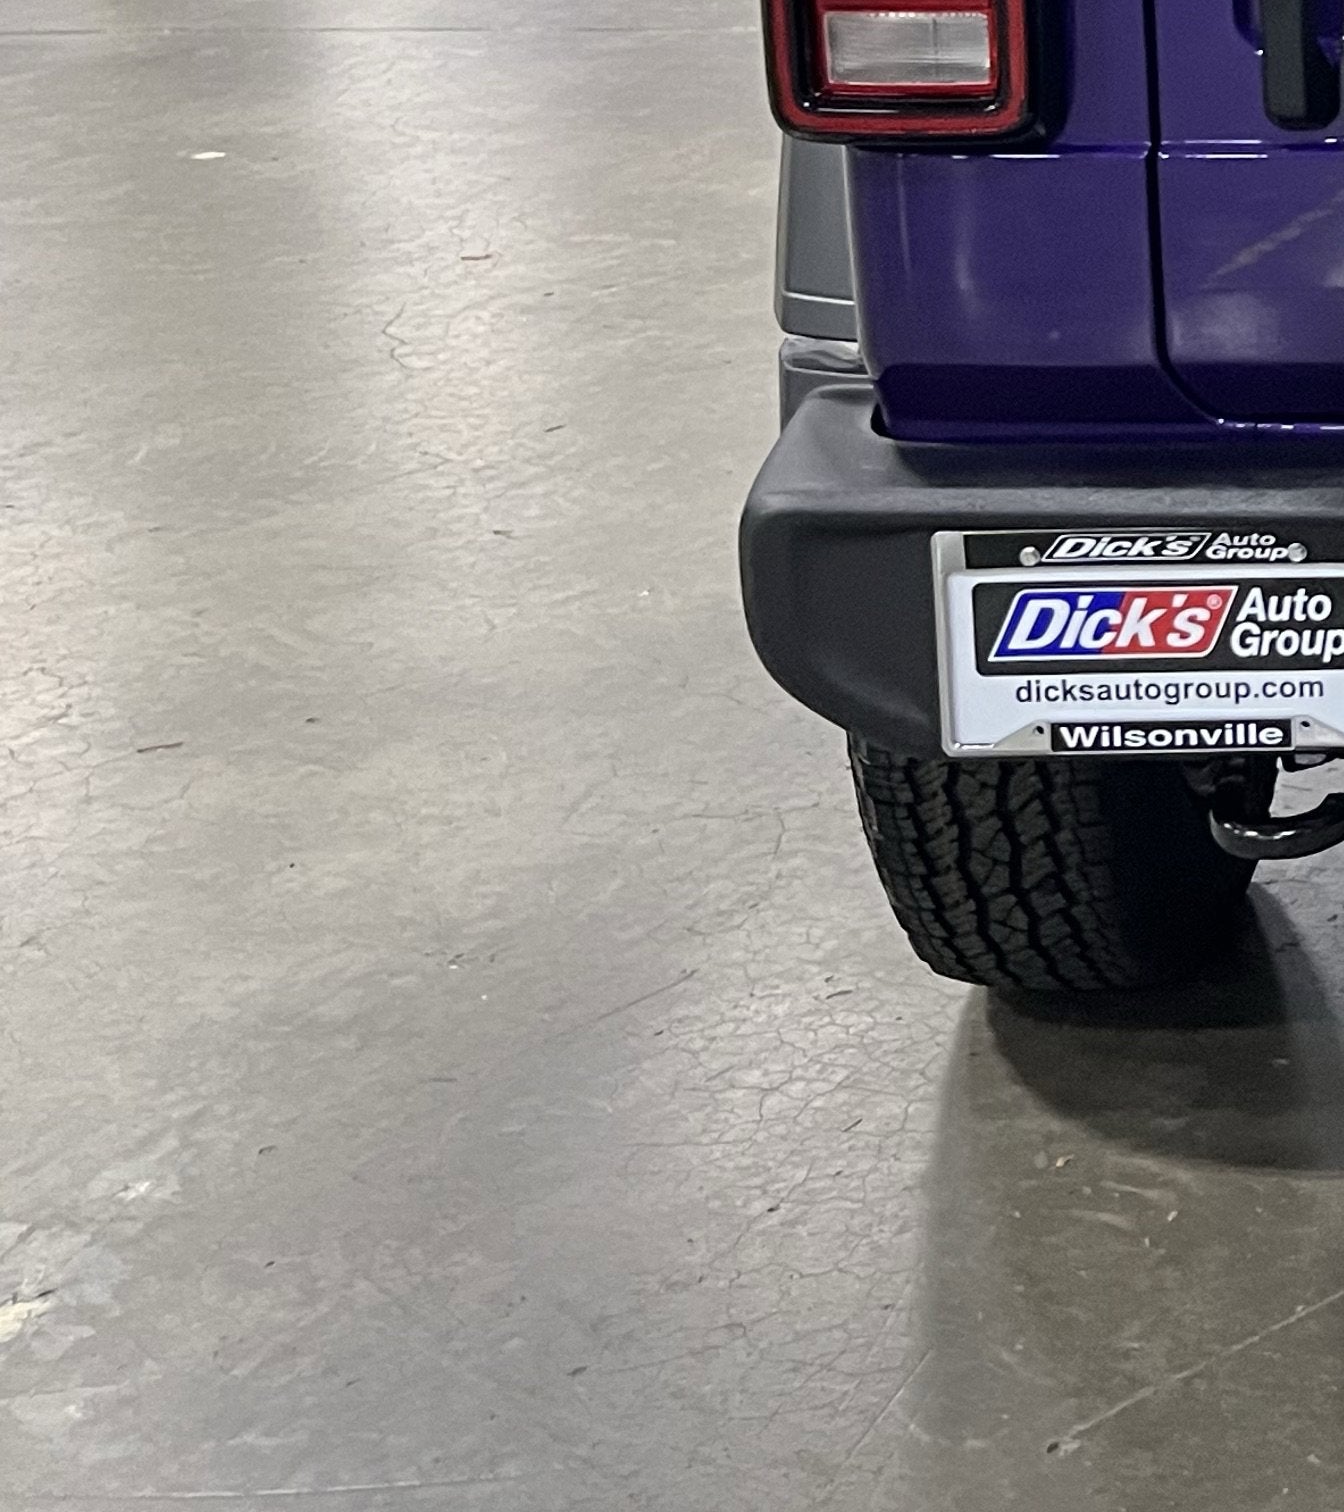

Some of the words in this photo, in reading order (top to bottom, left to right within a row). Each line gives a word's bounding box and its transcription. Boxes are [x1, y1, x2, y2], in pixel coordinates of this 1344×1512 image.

[1212, 533, 1276, 546] Auto
[1206, 544, 1289, 561] Group
[1236, 587, 1332, 622] Auto
[1007, 594, 1210, 649] Dick's
[1016, 679, 1324, 705] dicksautogroup.com
[1060, 723, 1283, 748] Wilsonville
